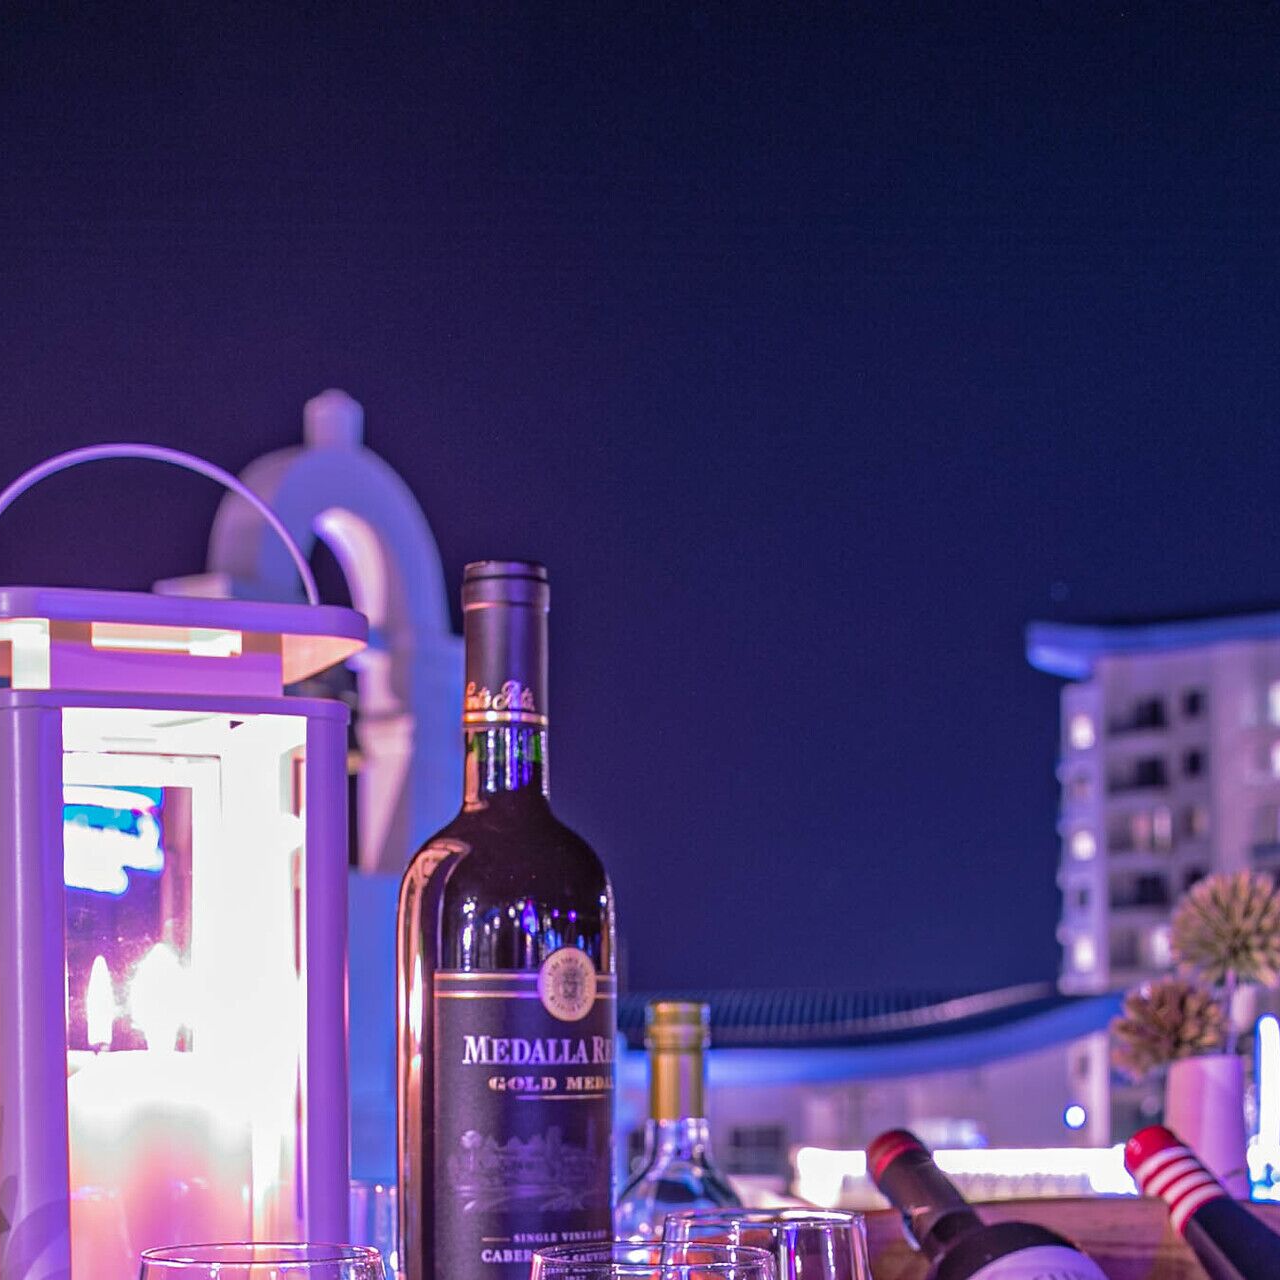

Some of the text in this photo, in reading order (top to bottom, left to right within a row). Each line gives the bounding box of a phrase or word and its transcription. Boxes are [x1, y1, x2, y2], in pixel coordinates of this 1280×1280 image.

[462, 1035, 589, 1064] MEDALLA
[488, 1075, 558, 1092] GOLD
[513, 1231, 558, 1243] SINGLE
